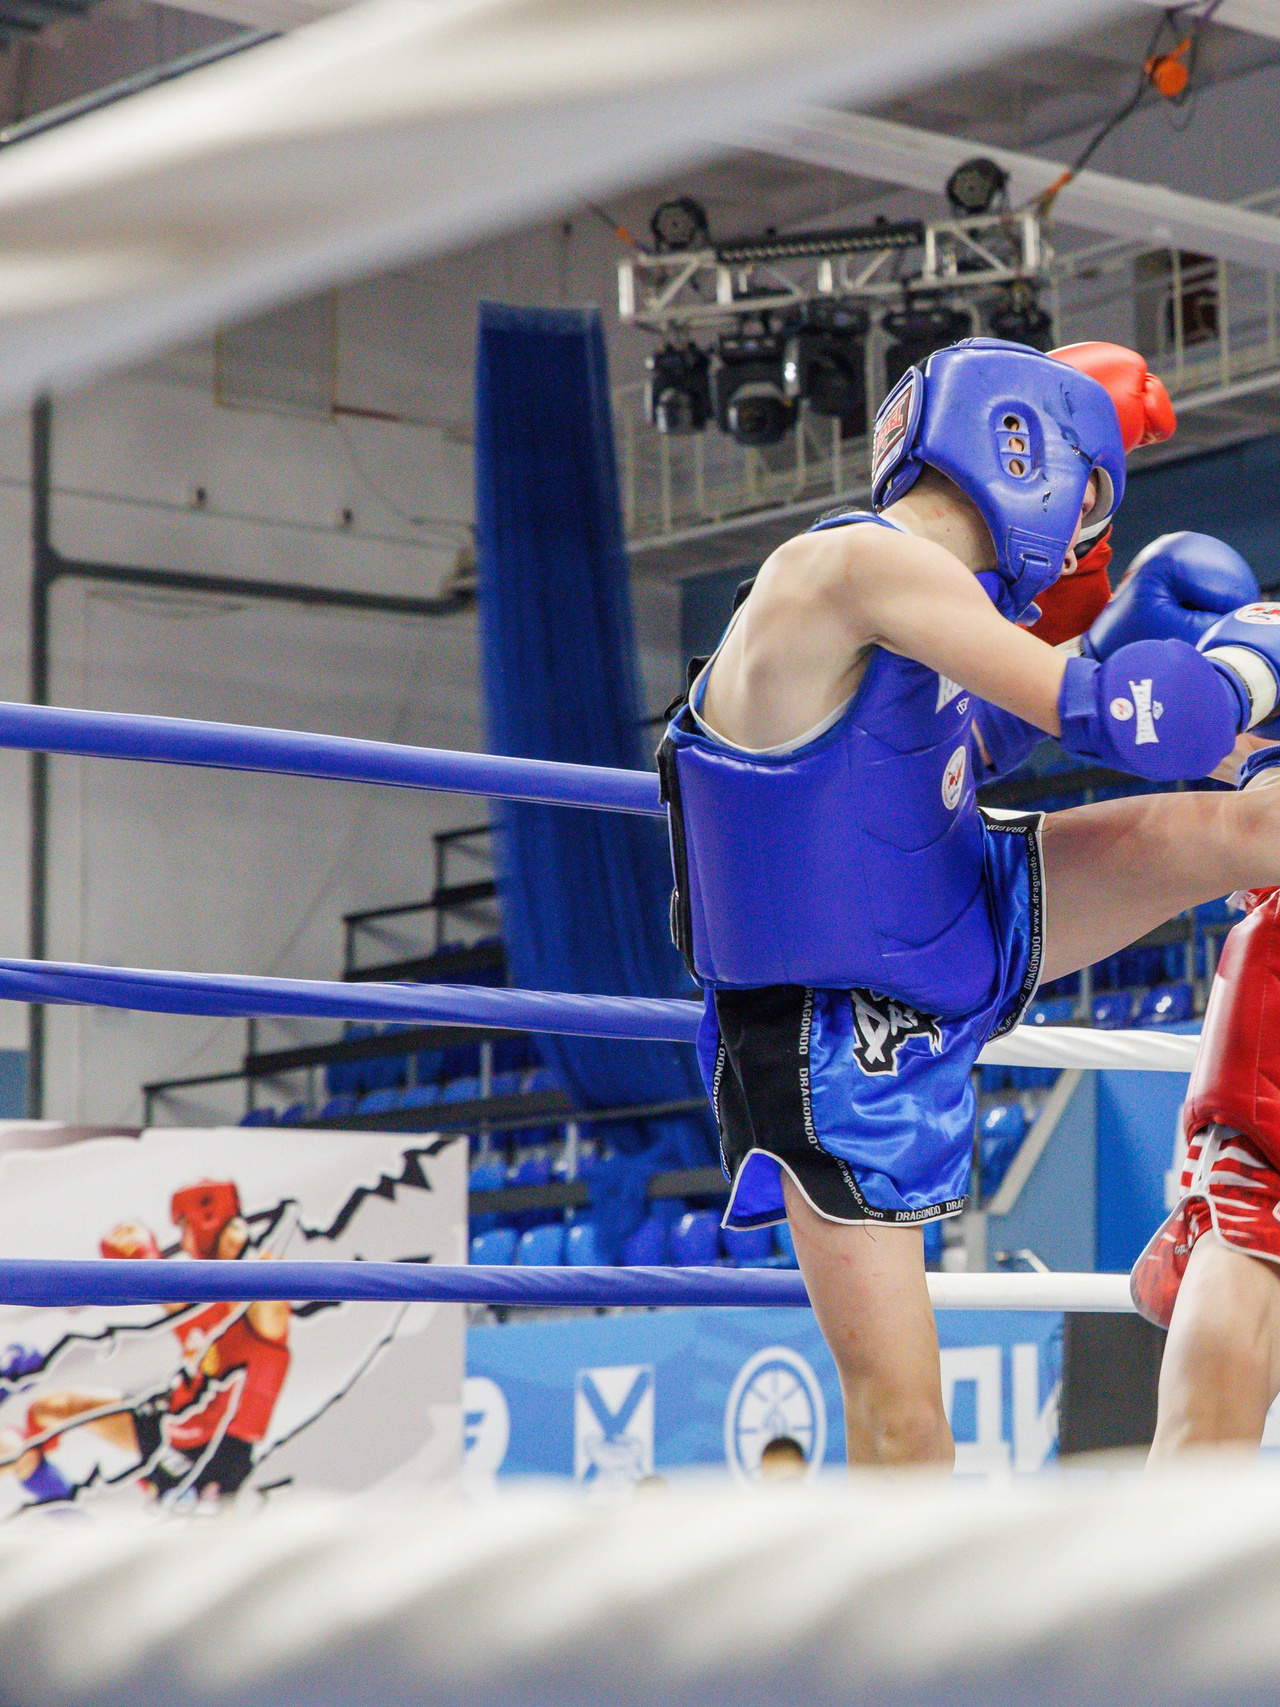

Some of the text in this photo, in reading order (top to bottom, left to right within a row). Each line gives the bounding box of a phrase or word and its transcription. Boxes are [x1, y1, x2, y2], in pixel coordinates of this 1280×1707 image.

[985, 824, 1028, 834] DRAGON
[1023, 936, 1042, 990] DRAGONDO
[799, 985, 814, 1055] RAGONDO
[799, 1067, 818, 1144] DRAGONDO
[895, 1205, 941, 1222] DRAGONDO
